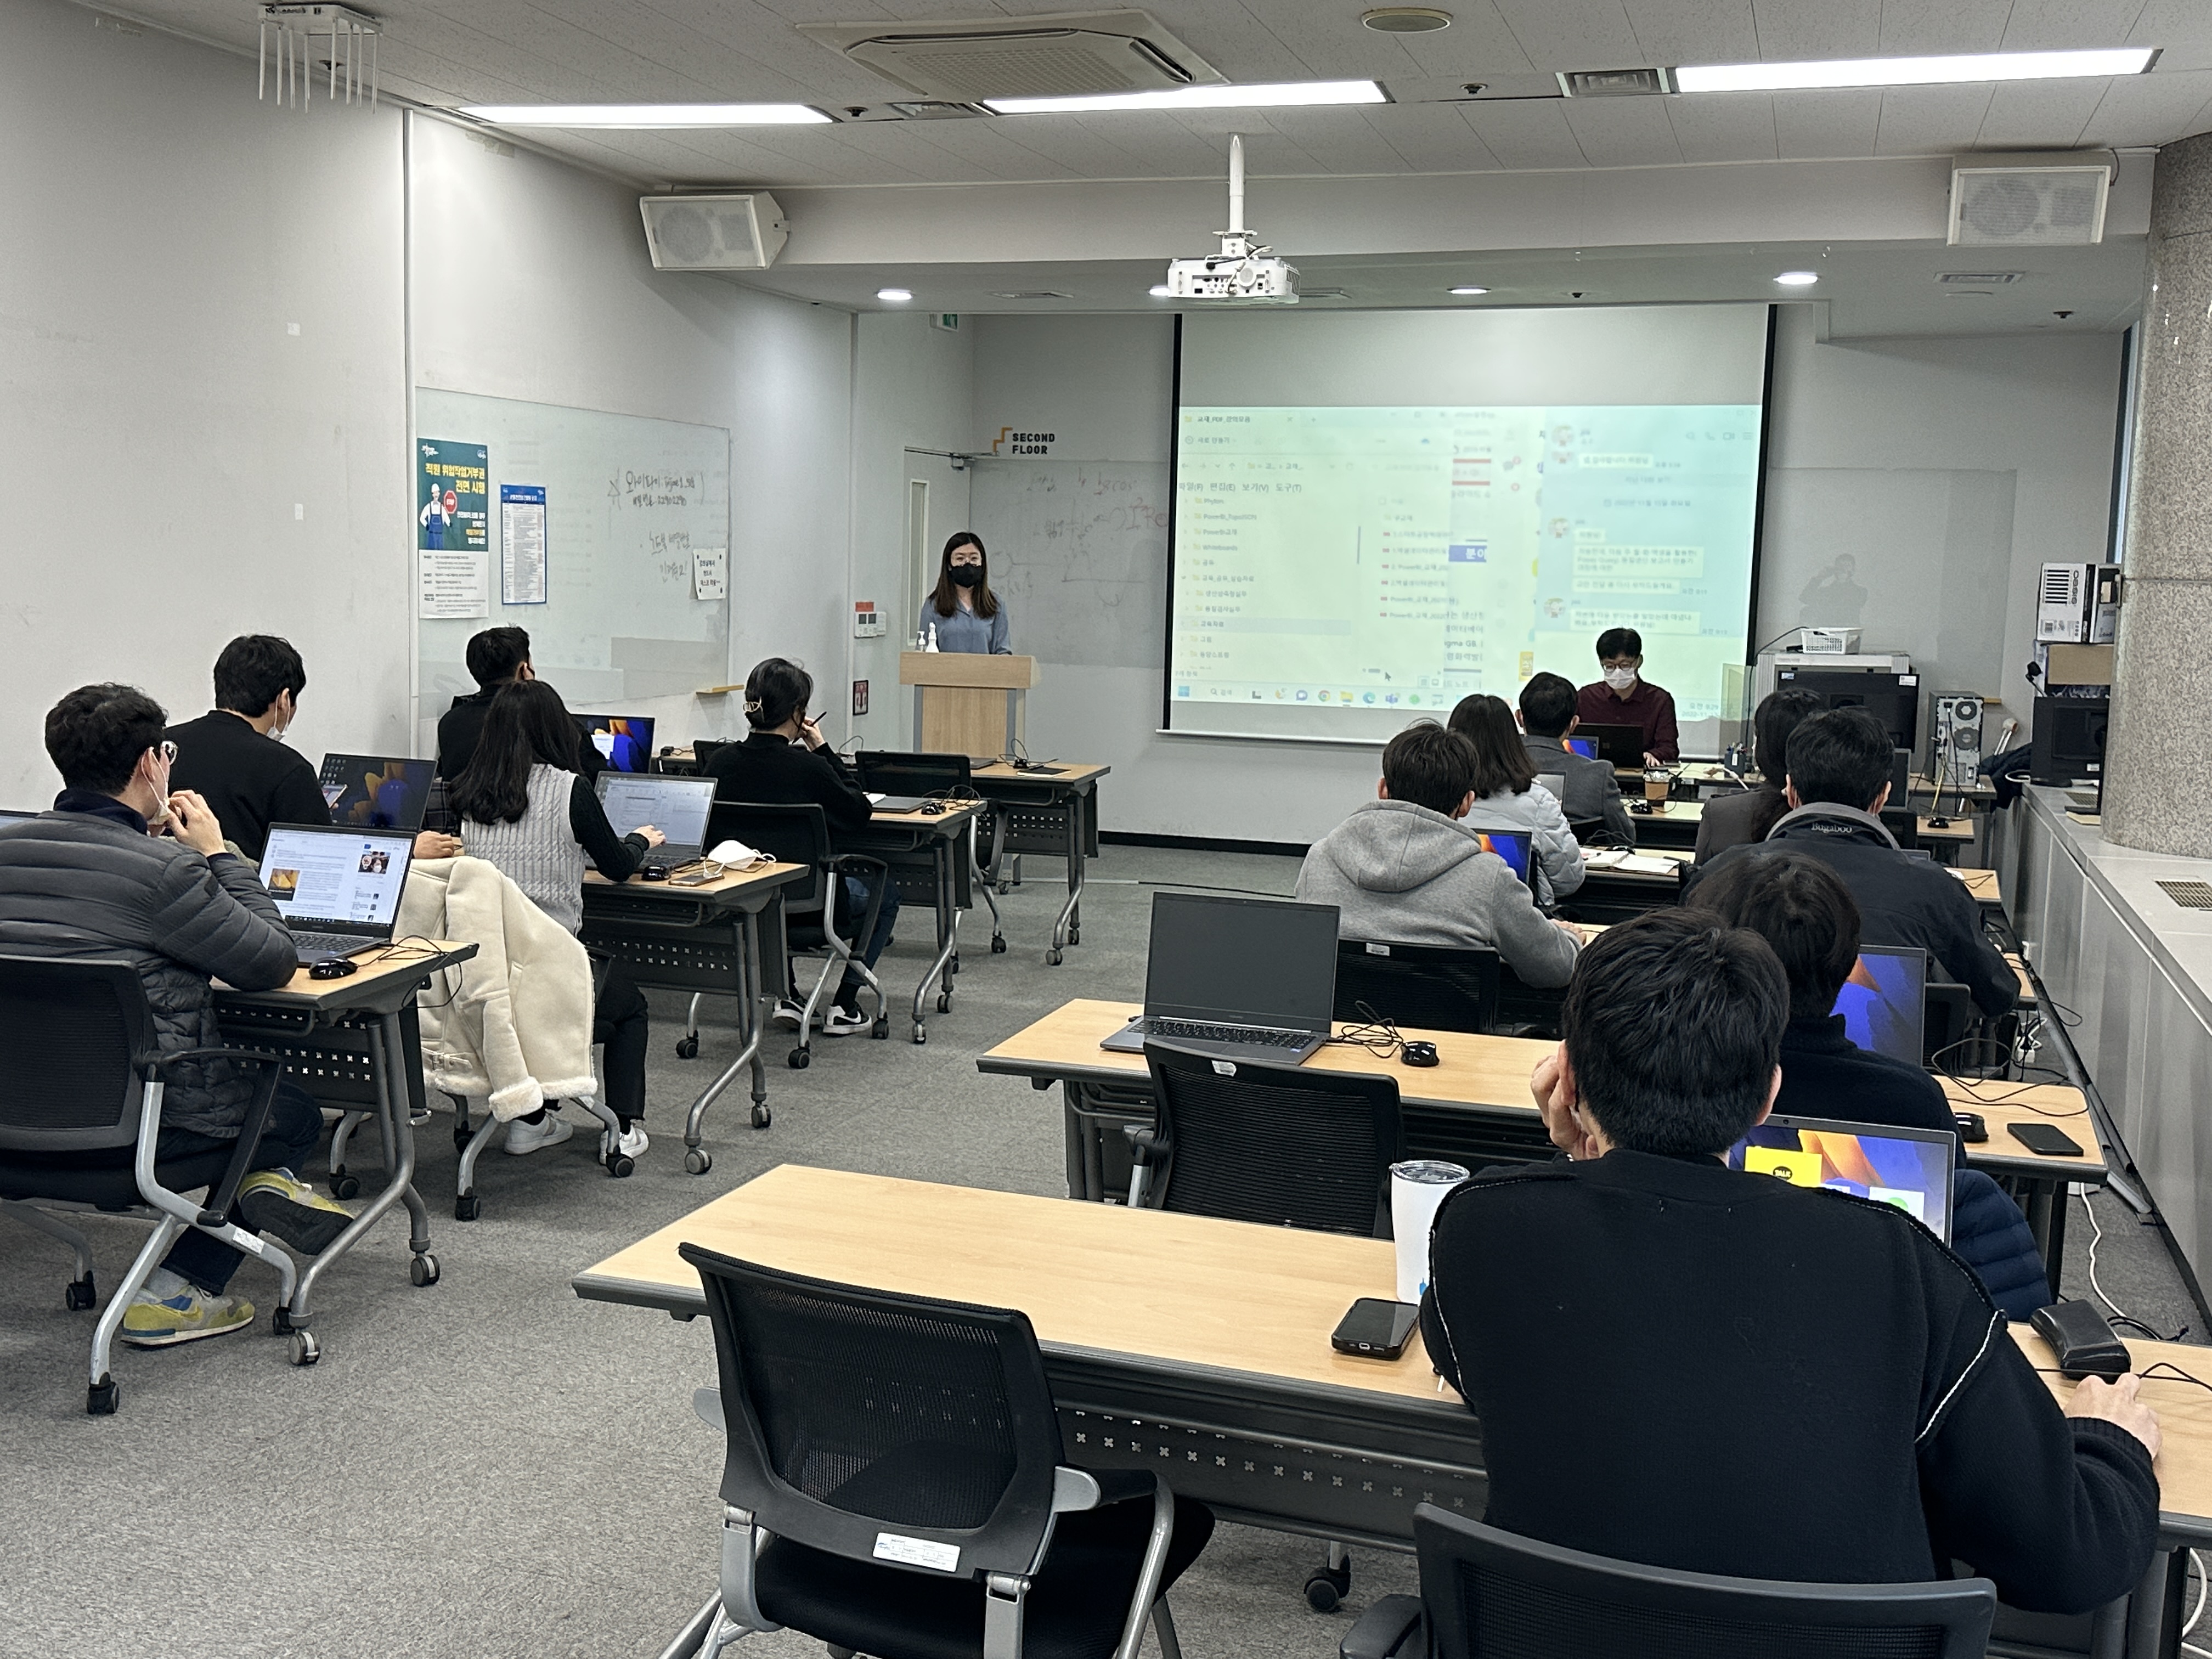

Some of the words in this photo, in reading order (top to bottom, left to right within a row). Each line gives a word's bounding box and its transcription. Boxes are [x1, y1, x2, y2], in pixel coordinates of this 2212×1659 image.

[1013, 433, 1055, 442] SECOND
[1013, 445, 1047, 454] FLOOR
[1242, 483, 1269, 493] 보기(V)
[1276, 484, 1302, 493] 도구(T)
